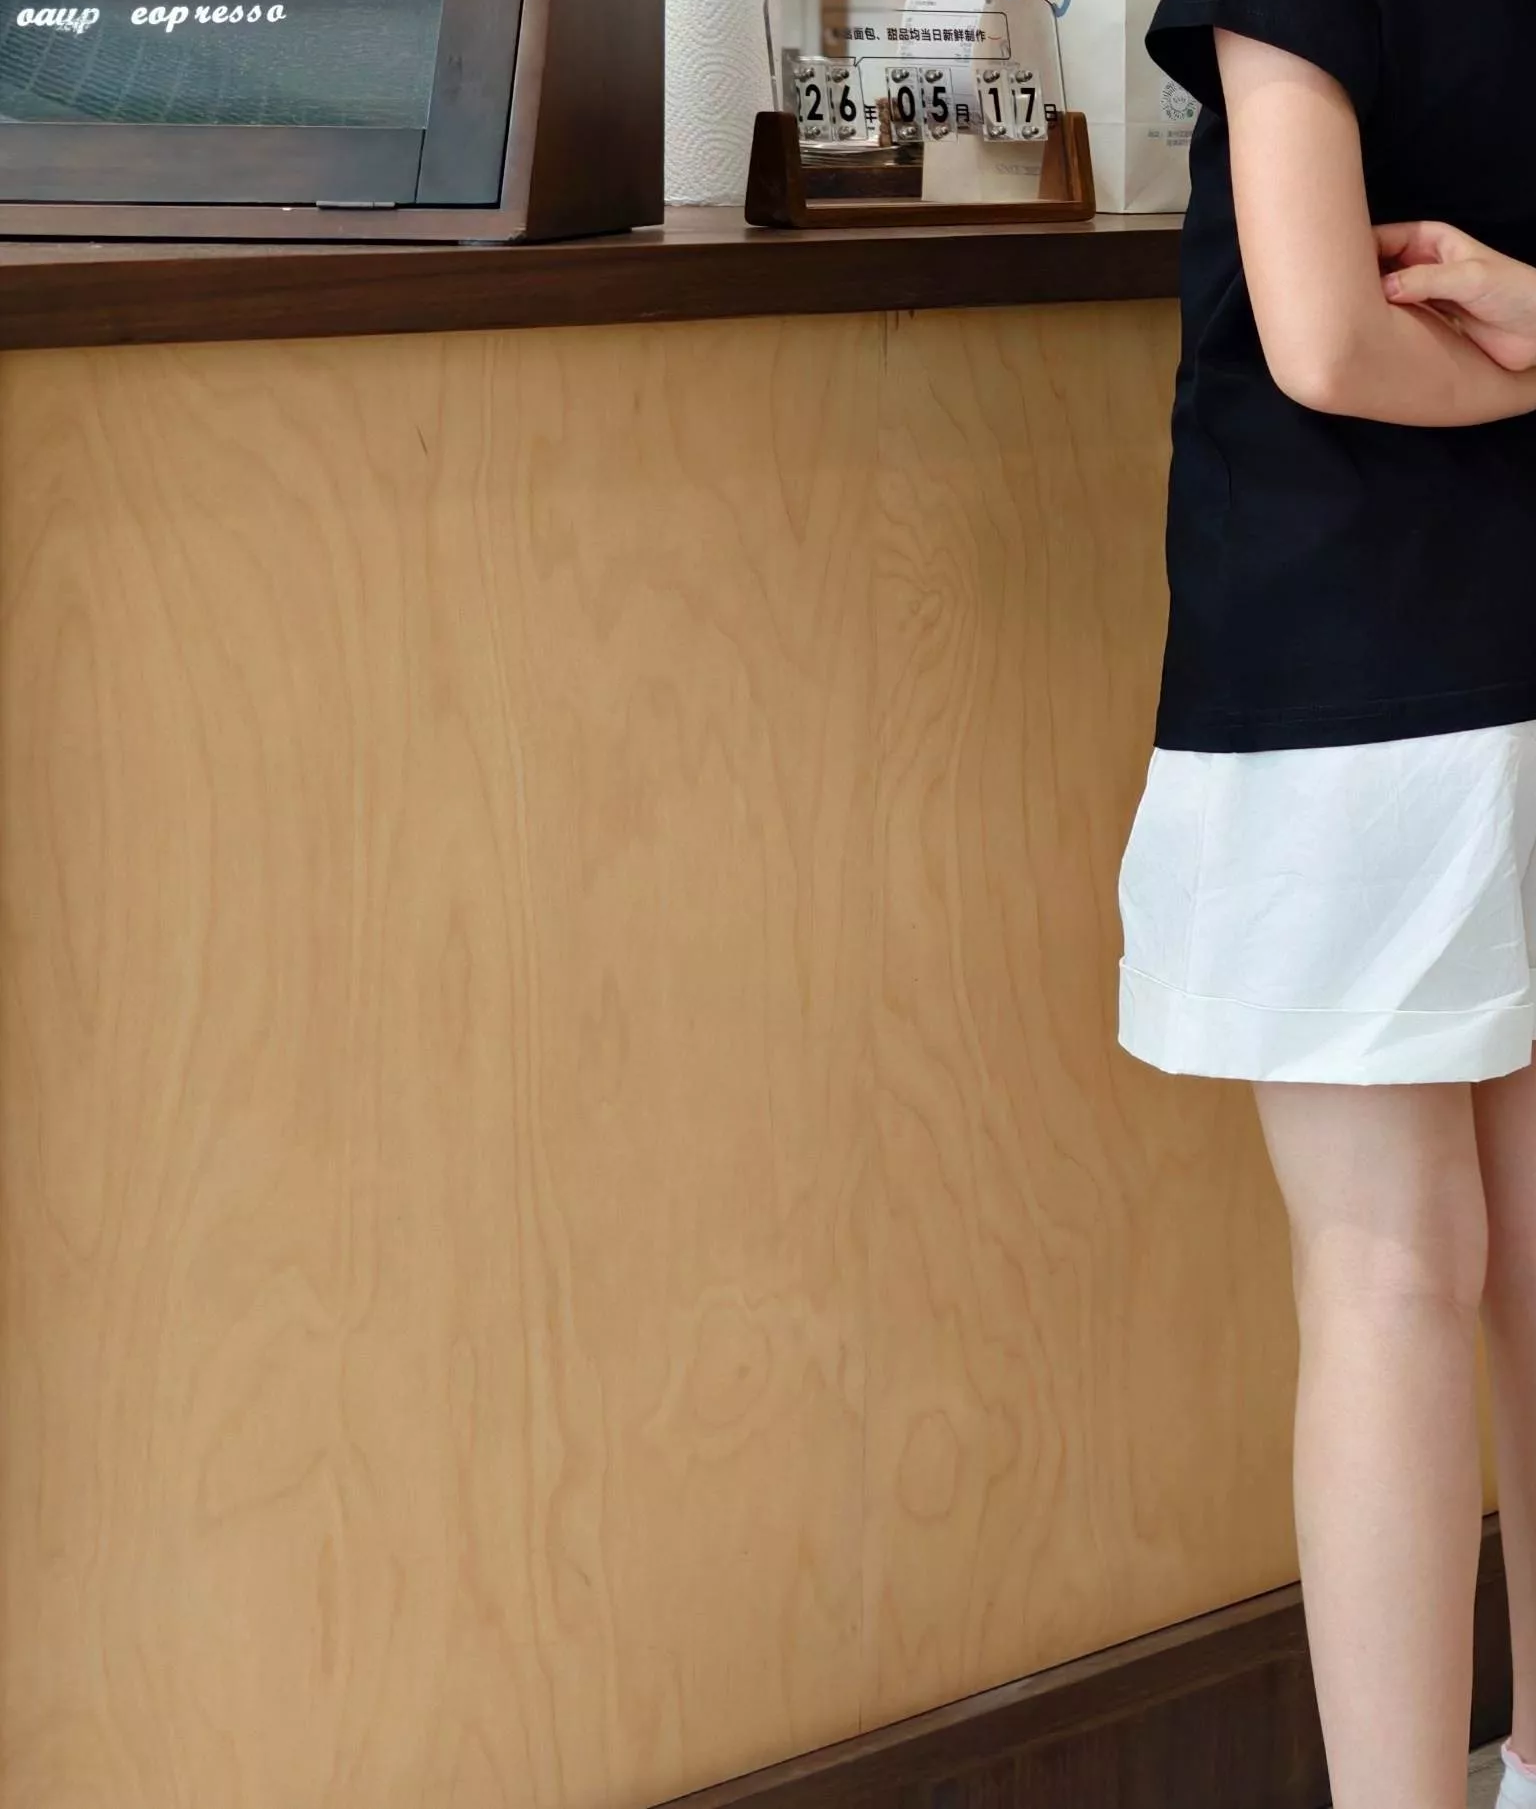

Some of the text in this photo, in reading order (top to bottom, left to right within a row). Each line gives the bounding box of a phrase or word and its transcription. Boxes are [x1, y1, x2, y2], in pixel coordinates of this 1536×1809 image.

[831, 26, 987, 43] 面包、甜品均当日新鲜制作
